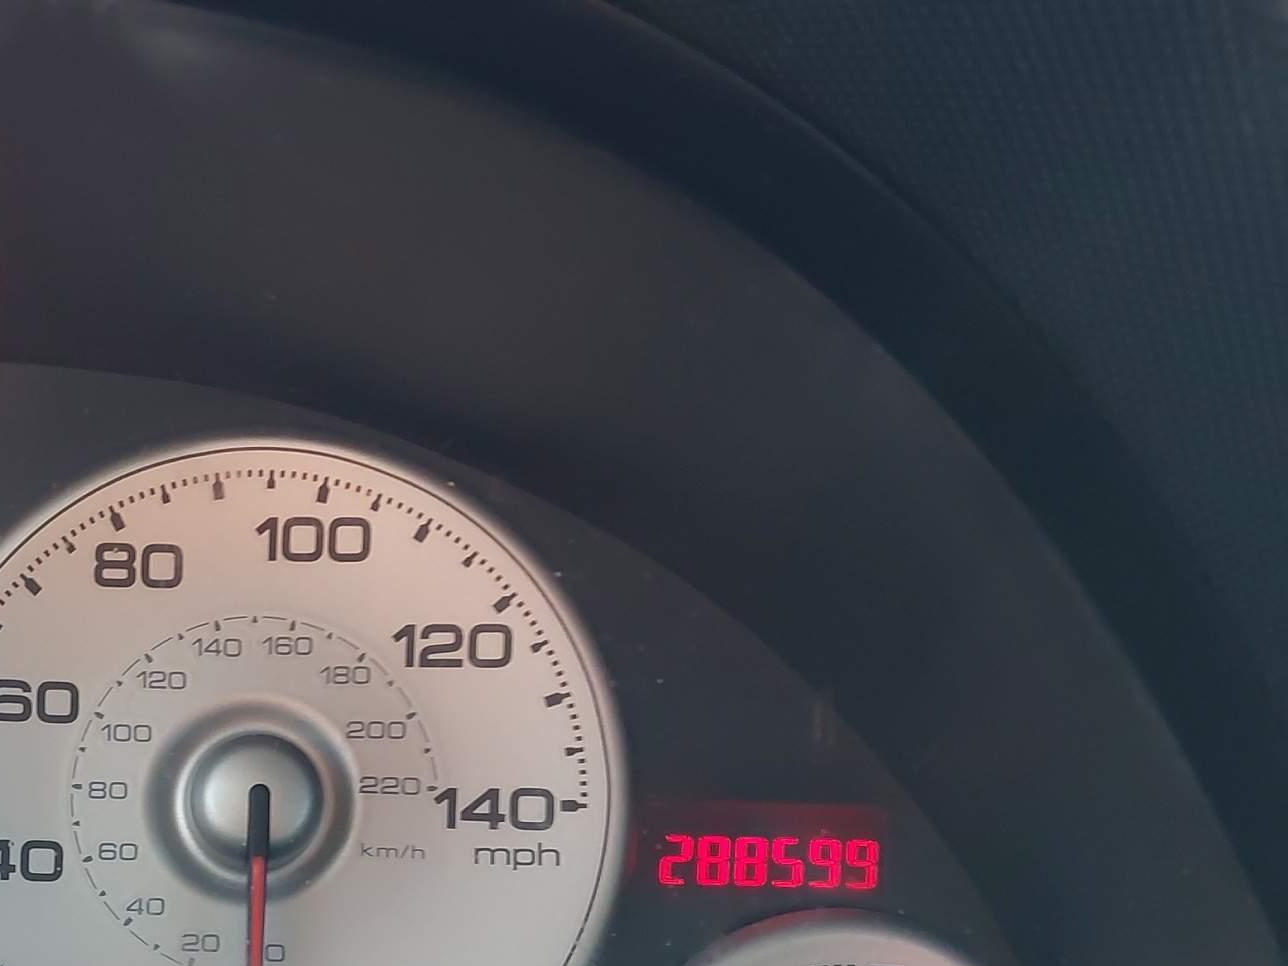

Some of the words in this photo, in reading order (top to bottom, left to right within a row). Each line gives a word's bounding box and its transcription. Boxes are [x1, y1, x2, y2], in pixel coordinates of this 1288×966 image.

[255, 516, 371, 563] 100
[94, 543, 184, 589] 80
[192, 638, 243, 659] 140
[261, 636, 314, 657] 160
[392, 623, 512, 669] 120
[136, 671, 187, 691] 120
[319, 665, 372, 686] 180
[101, 723, 153, 743] 100
[345, 720, 407, 741] 200
[87, 781, 128, 800] 80
[358, 775, 422, 796] 220
[433, 787, 556, 832] 140
[97, 843, 139, 862] 60
[360, 842, 426, 862] km/h
[473, 842, 561, 871] mph
[658, 834, 879, 890] 288599
[126, 897, 166, 917] 40
[180, 934, 221, 953] 20
[265, 944, 286, 962] 0
